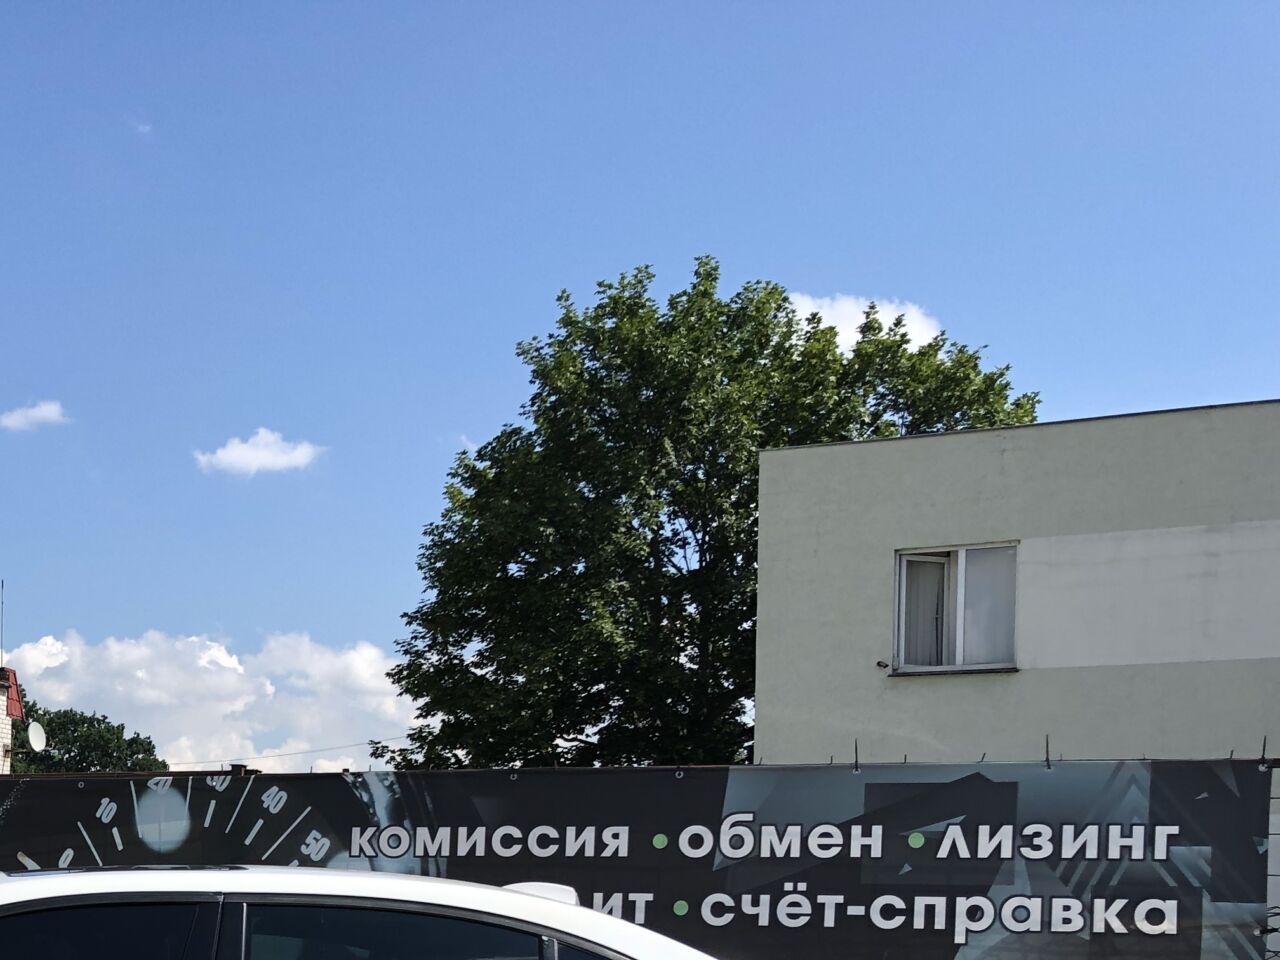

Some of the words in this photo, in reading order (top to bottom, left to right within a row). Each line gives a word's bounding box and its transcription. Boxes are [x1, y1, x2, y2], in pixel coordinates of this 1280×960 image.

[96, 797, 117, 823] 10
[261, 786, 287, 814] 40
[300, 829, 330, 861] 50
[349, 825, 629, 858] комиссия
[678, 813, 883, 858] обмен
[936, 824, 1179, 860] лизинг
[593, 892, 654, 925] ит
[700, 882, 1178, 944] счёт-справка
